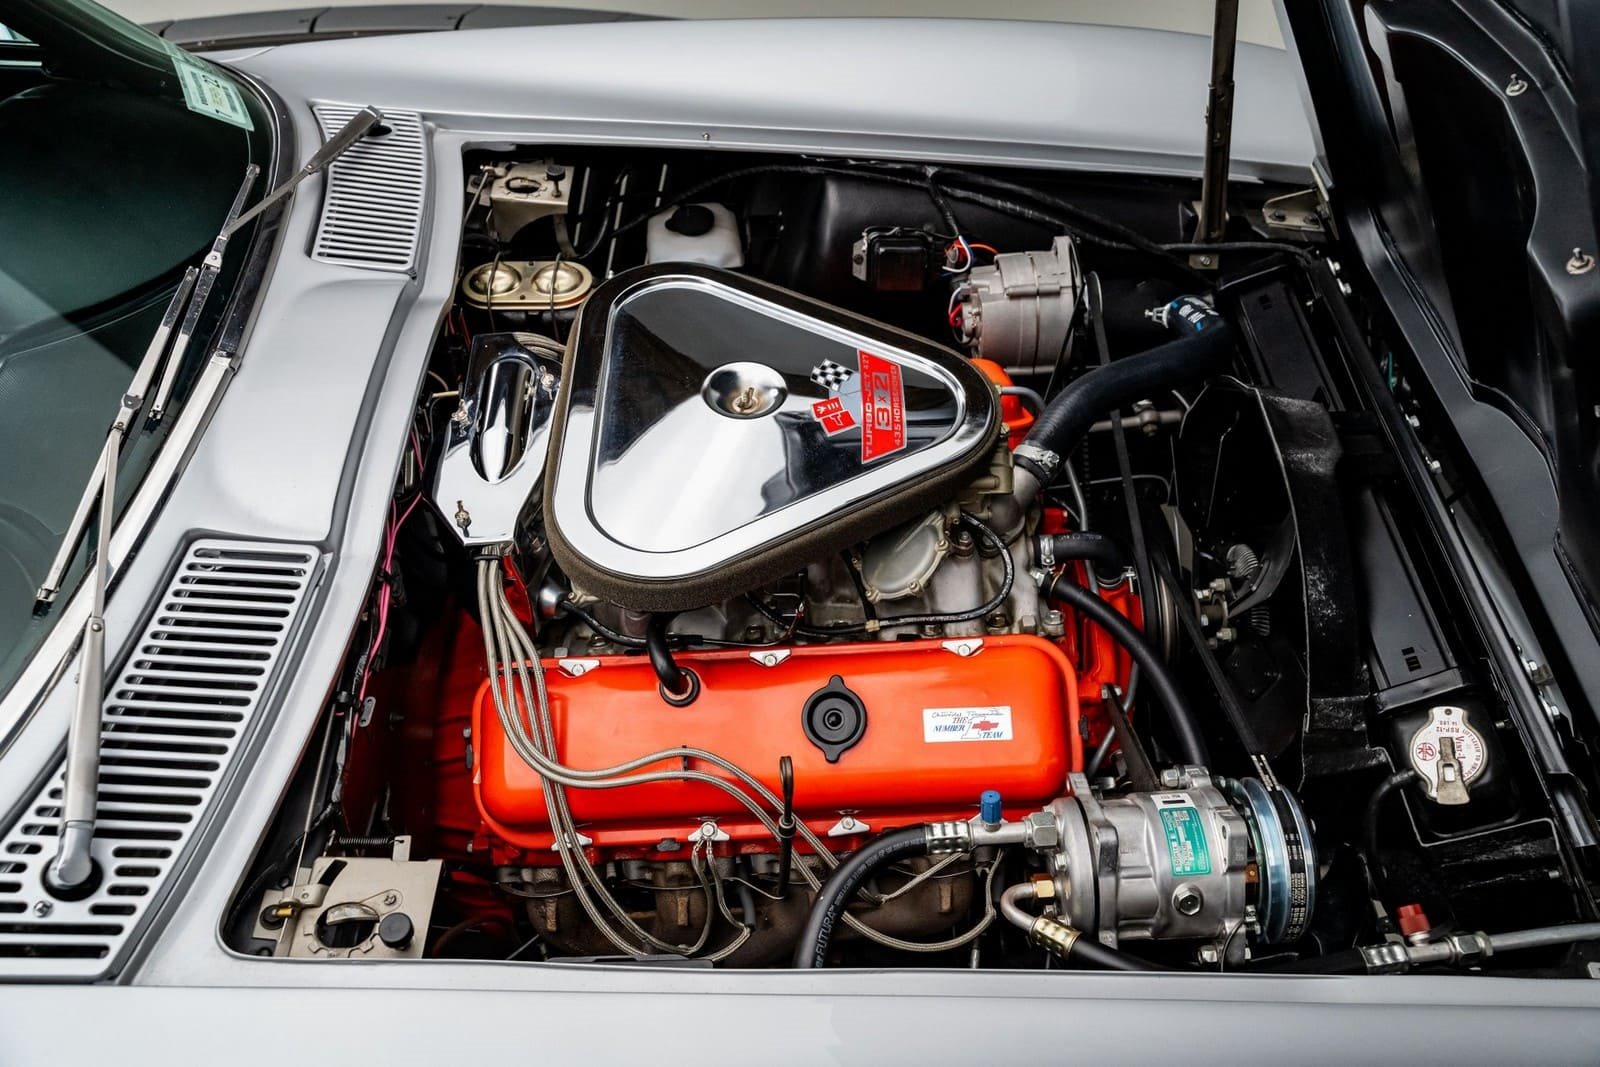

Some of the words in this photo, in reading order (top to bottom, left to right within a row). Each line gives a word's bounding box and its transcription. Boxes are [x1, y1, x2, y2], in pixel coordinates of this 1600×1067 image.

[862, 354, 870, 370] 427
[891, 365, 900, 422] HORSEPOWER
[893, 424, 901, 446] 435
[952, 716, 969, 724] THE
[935, 724, 966, 732] NUMBER
[982, 731, 1003, 739] TEAM
